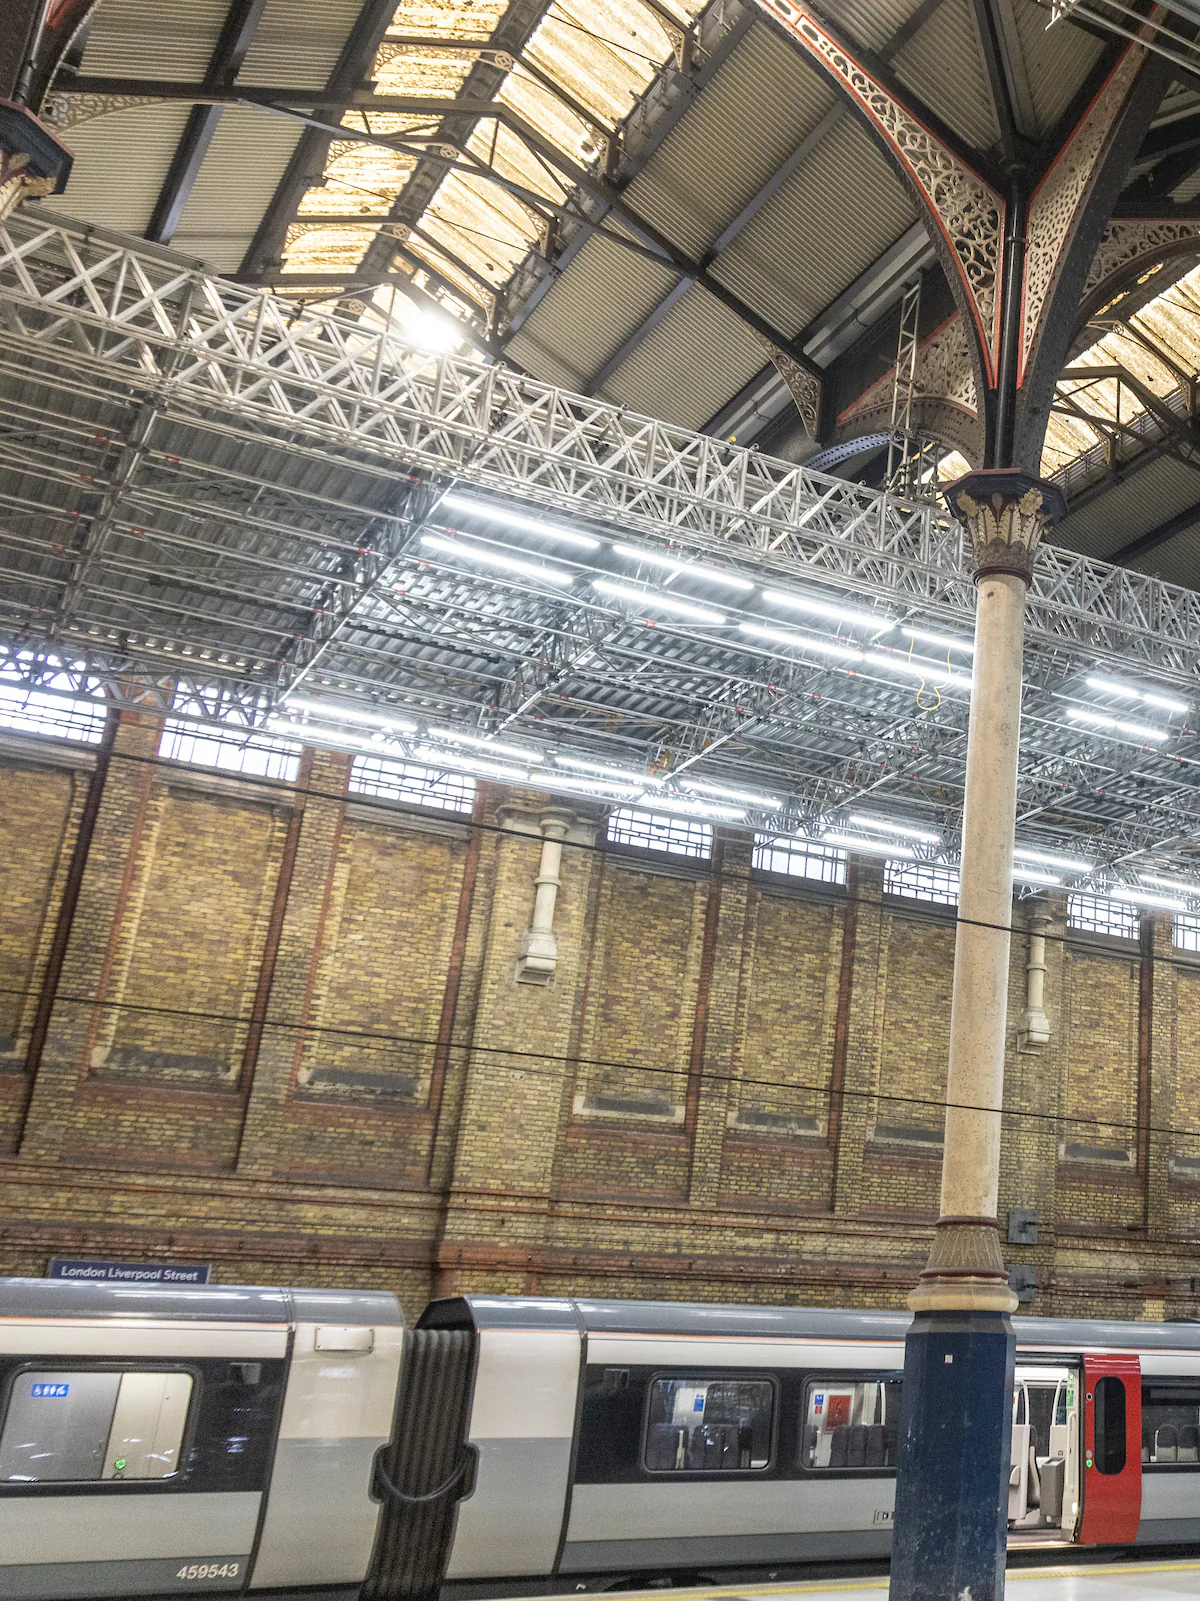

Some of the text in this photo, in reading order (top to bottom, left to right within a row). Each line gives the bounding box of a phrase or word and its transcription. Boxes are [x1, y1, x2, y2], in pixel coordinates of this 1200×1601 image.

[61, 1265, 199, 1281] London Liverpool Street
[176, 1562, 240, 1580] 459543
